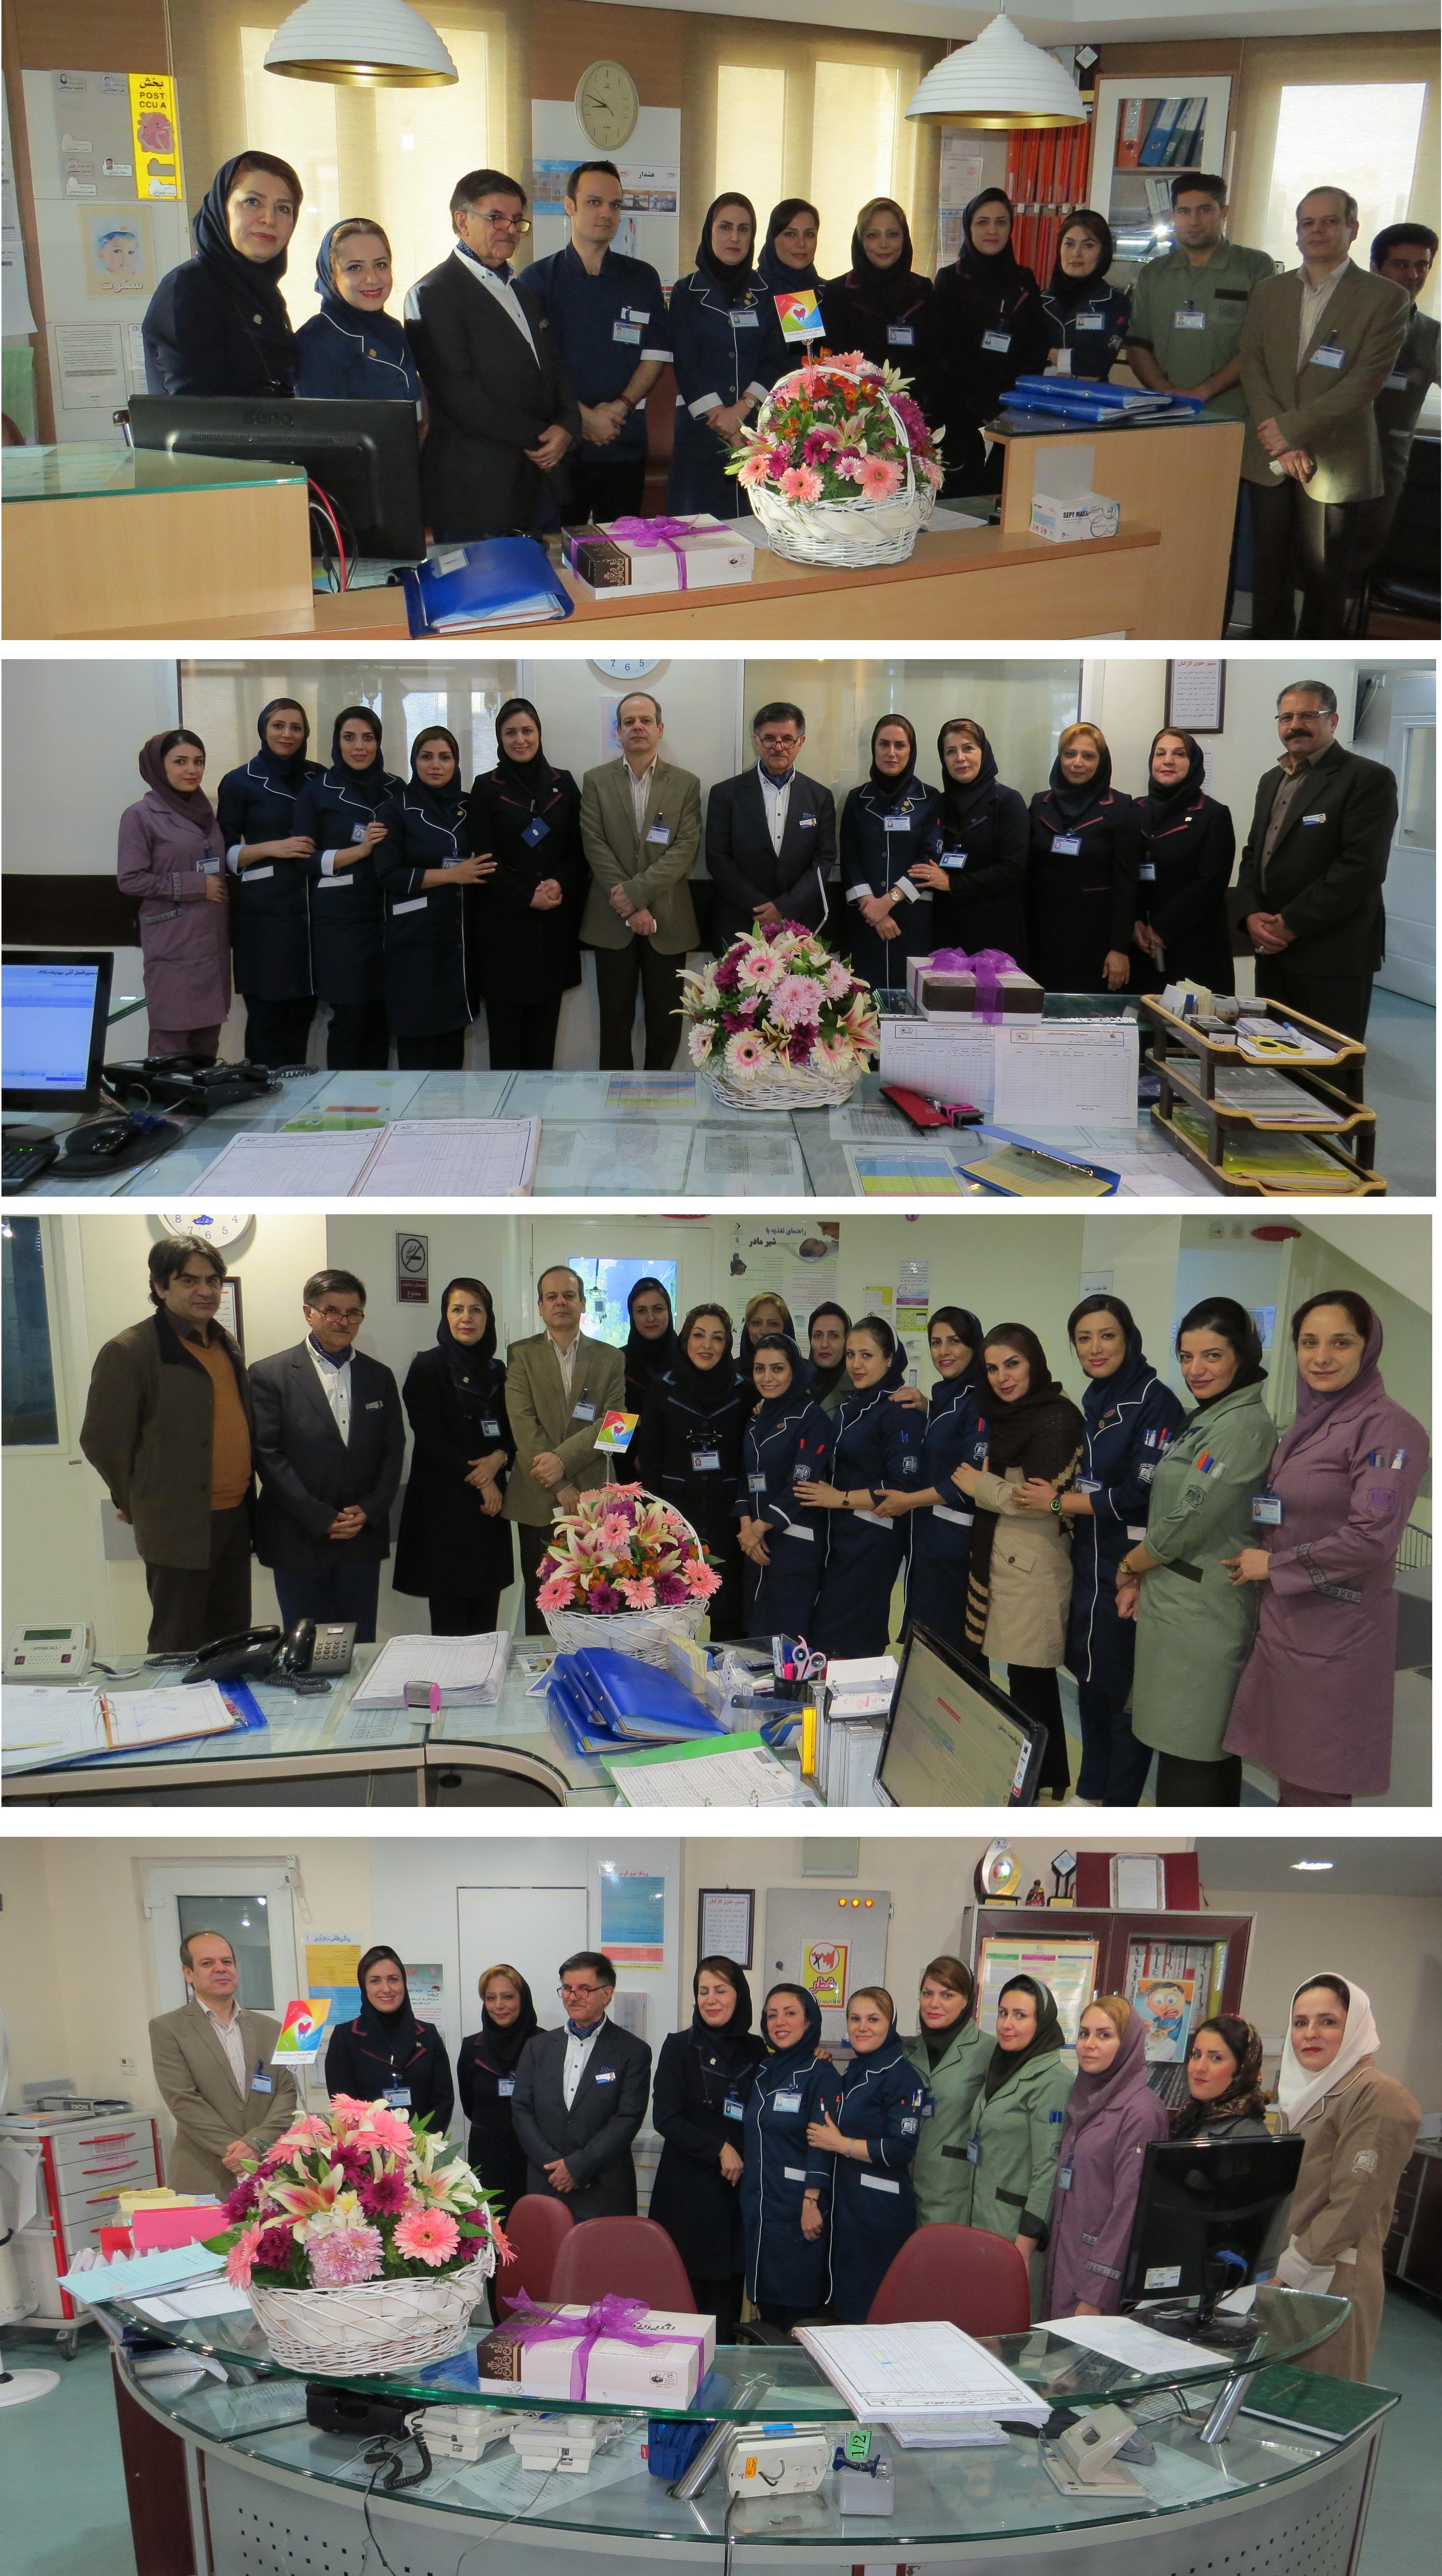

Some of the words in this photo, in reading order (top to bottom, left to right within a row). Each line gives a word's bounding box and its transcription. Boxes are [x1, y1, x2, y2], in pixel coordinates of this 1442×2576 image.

[140, 77, 164, 88] بخش
[100, 279, 144, 292] سکوت
[175, 1215, 182, 1223] 8
[188, 1226, 194, 1234] 7
[205, 1231, 211, 1239] 6
[786, 1227, 806, 1236] راهنمای
[748, 1237, 763, 1247] مادر
[764, 1237, 777, 1247] شیر
[810, 1977, 836, 1994] خطر
